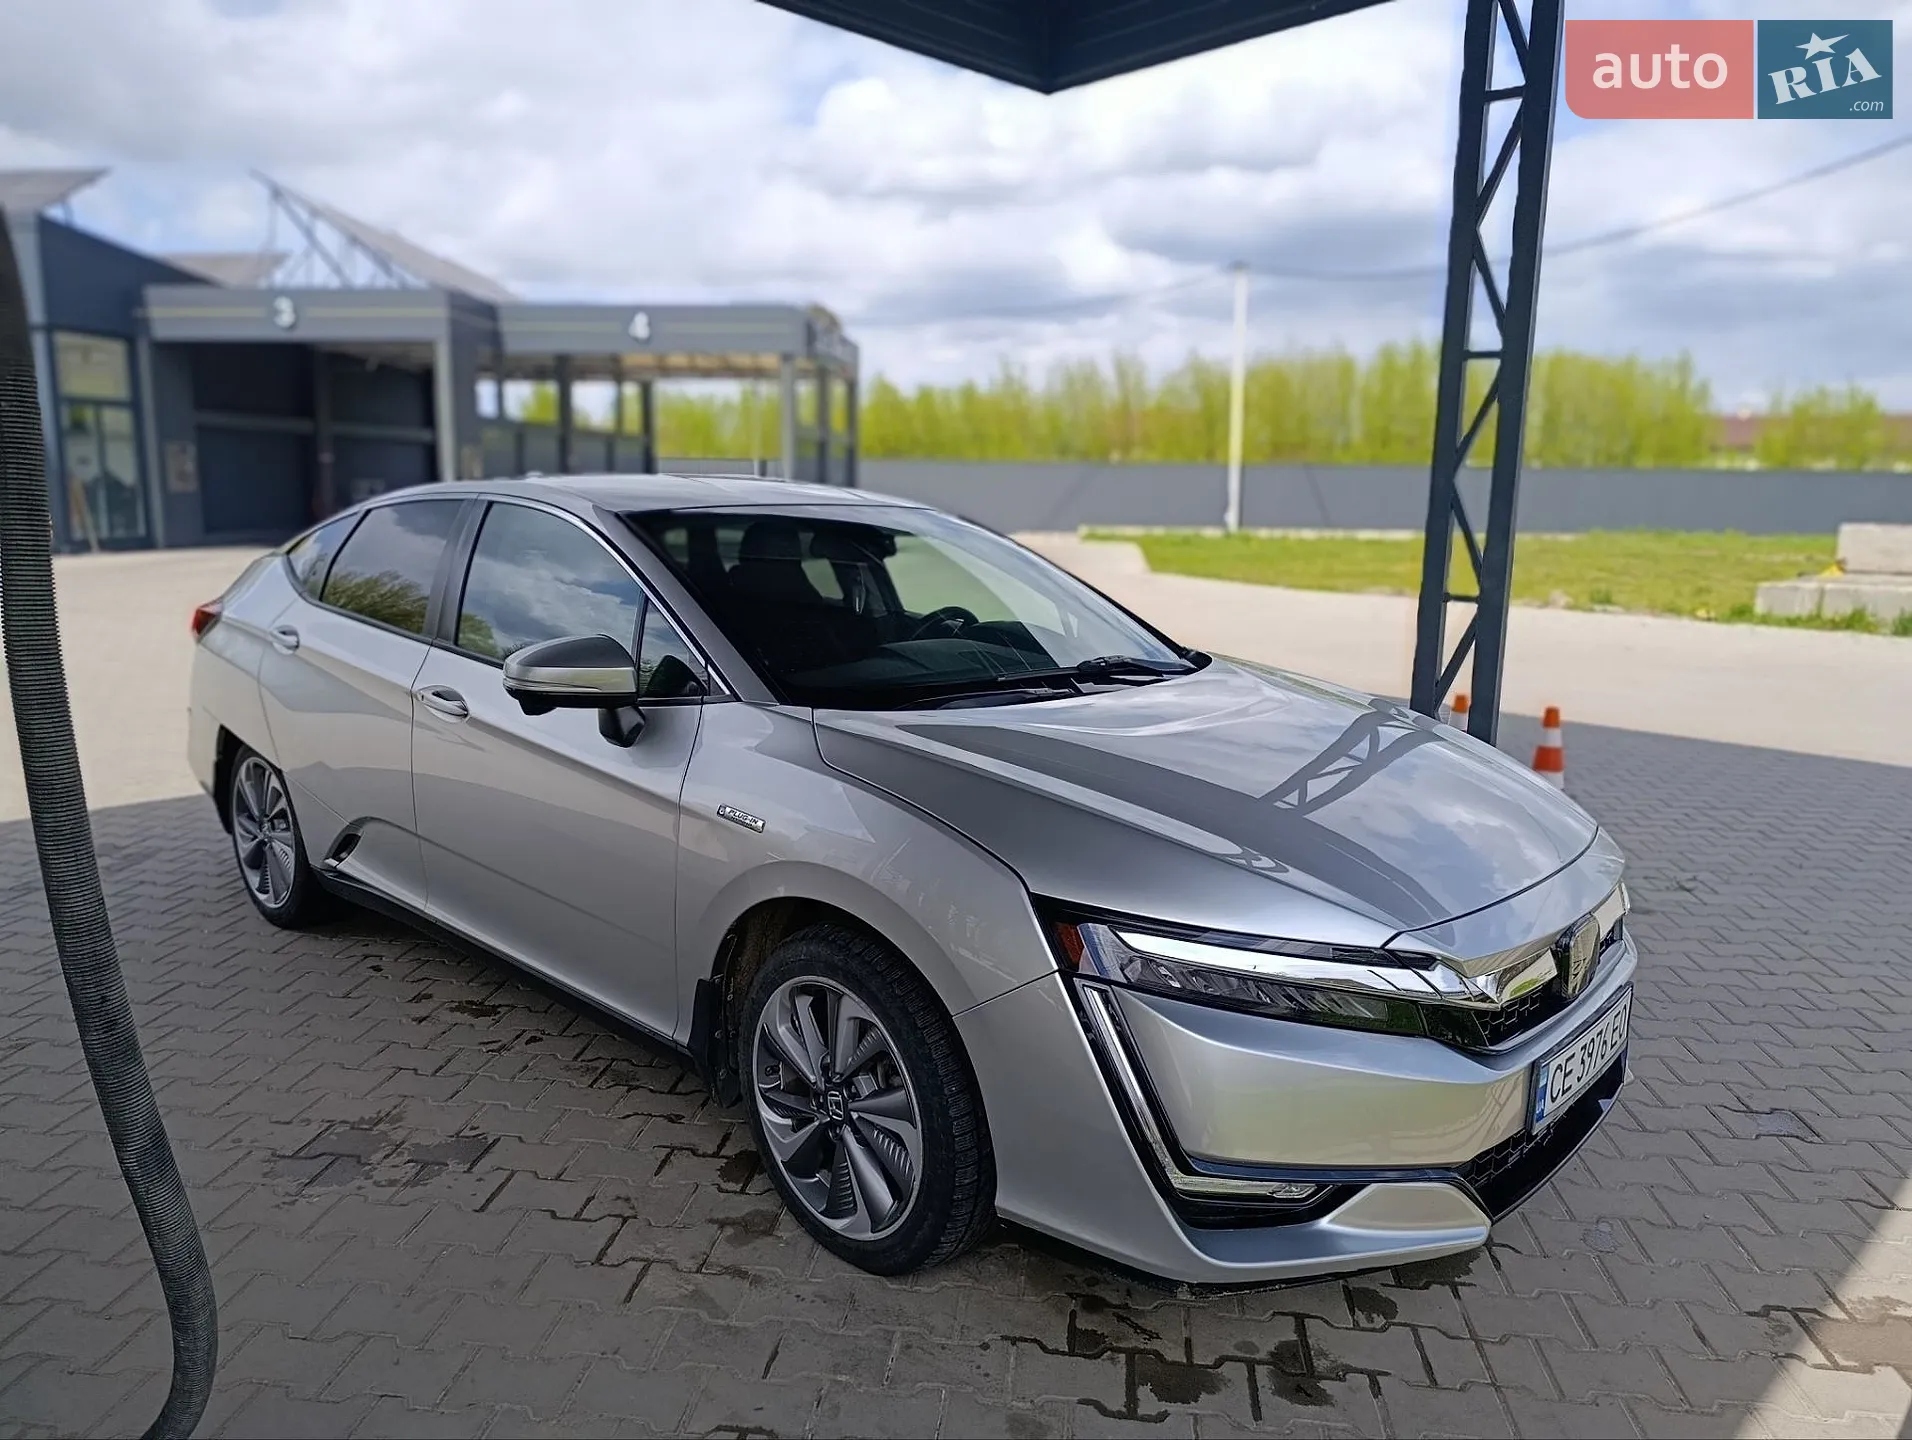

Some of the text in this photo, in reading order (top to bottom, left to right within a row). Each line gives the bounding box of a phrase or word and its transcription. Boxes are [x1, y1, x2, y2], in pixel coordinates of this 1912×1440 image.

[273, 295, 296, 328] 3
[628, 311, 651, 340] 4
[1550, 1051, 1576, 1103] CE
[1576, 1021, 1610, 1083] 3976
